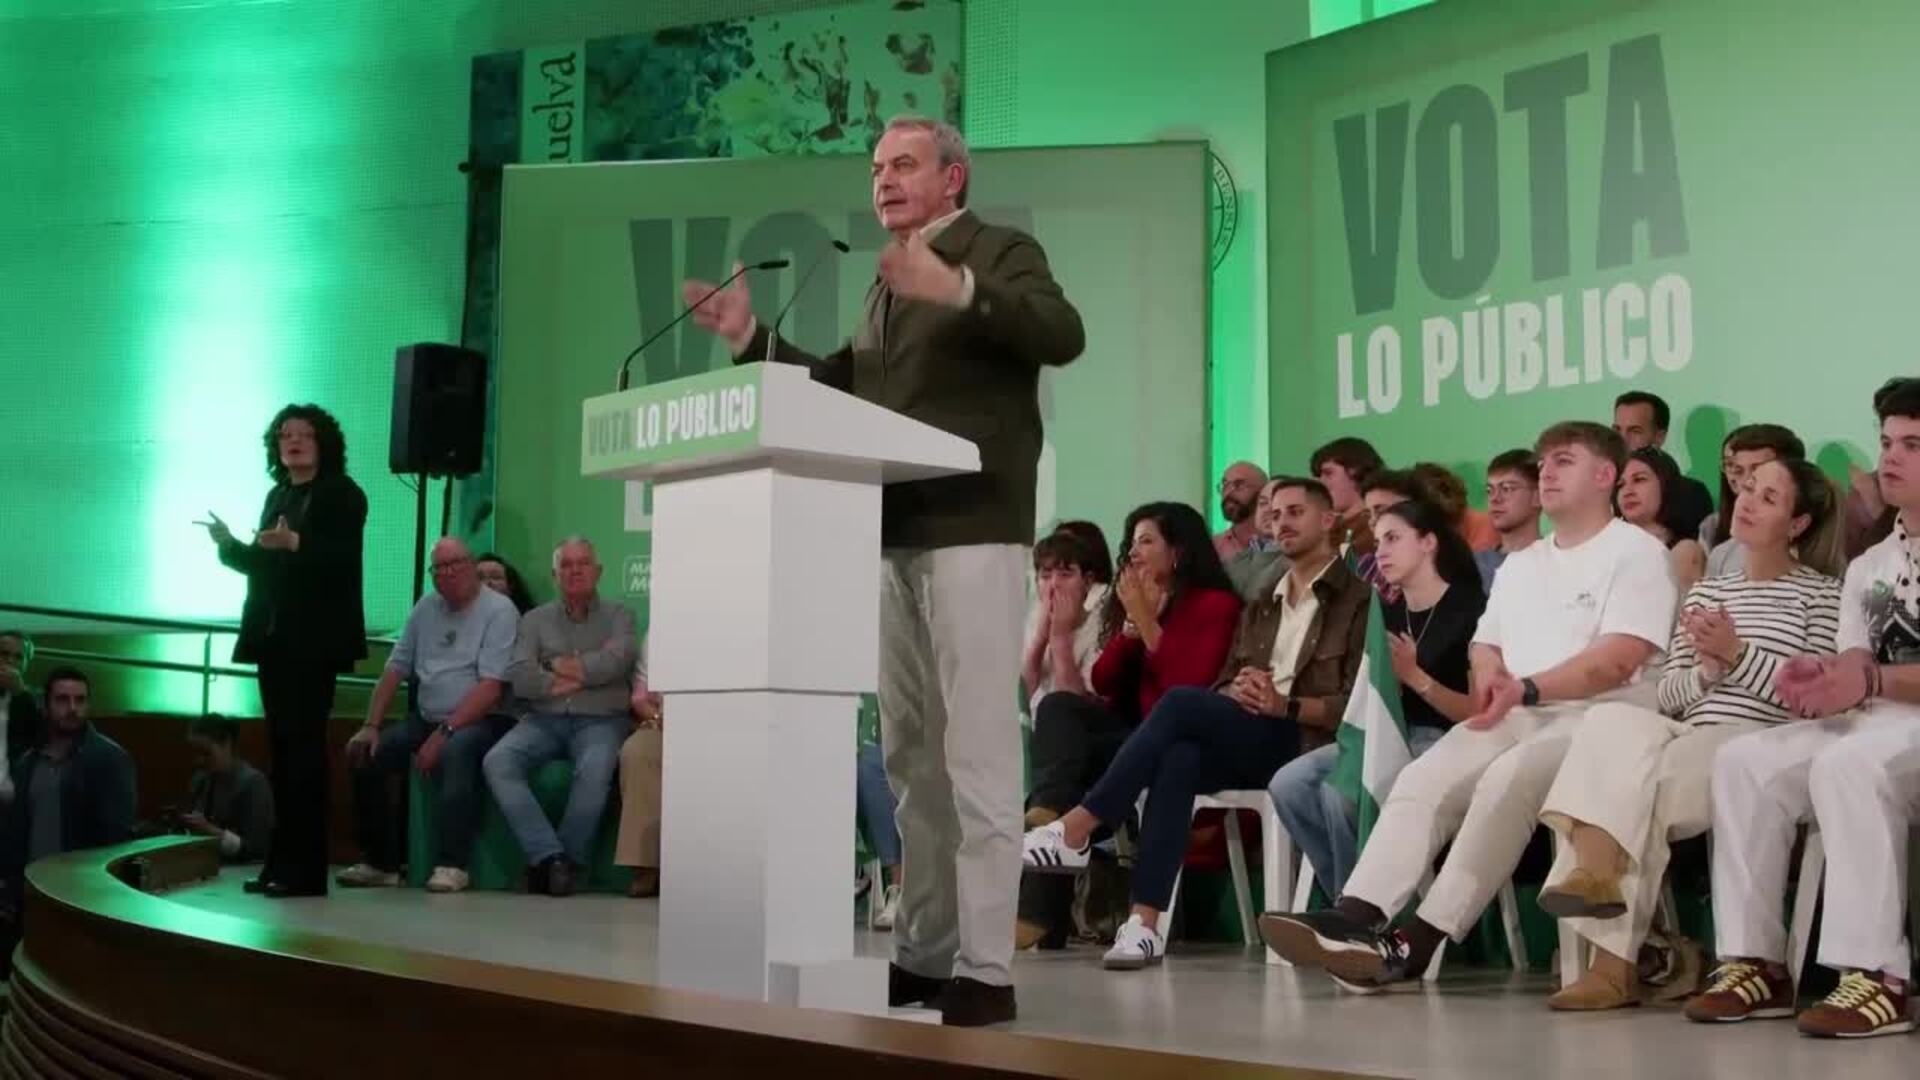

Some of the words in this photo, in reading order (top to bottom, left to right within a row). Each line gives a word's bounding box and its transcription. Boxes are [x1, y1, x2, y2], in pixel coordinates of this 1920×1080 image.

[532, 52, 576, 163] uelva
[1333, 34, 1690, 316] VOTA
[1337, 325, 1401, 419] LO
[1422, 273, 1693, 407] PÚBLICO
[588, 410, 633, 457] VOTA
[637, 404, 661, 449] LO
[667, 383, 756, 445] PÚBLICO
